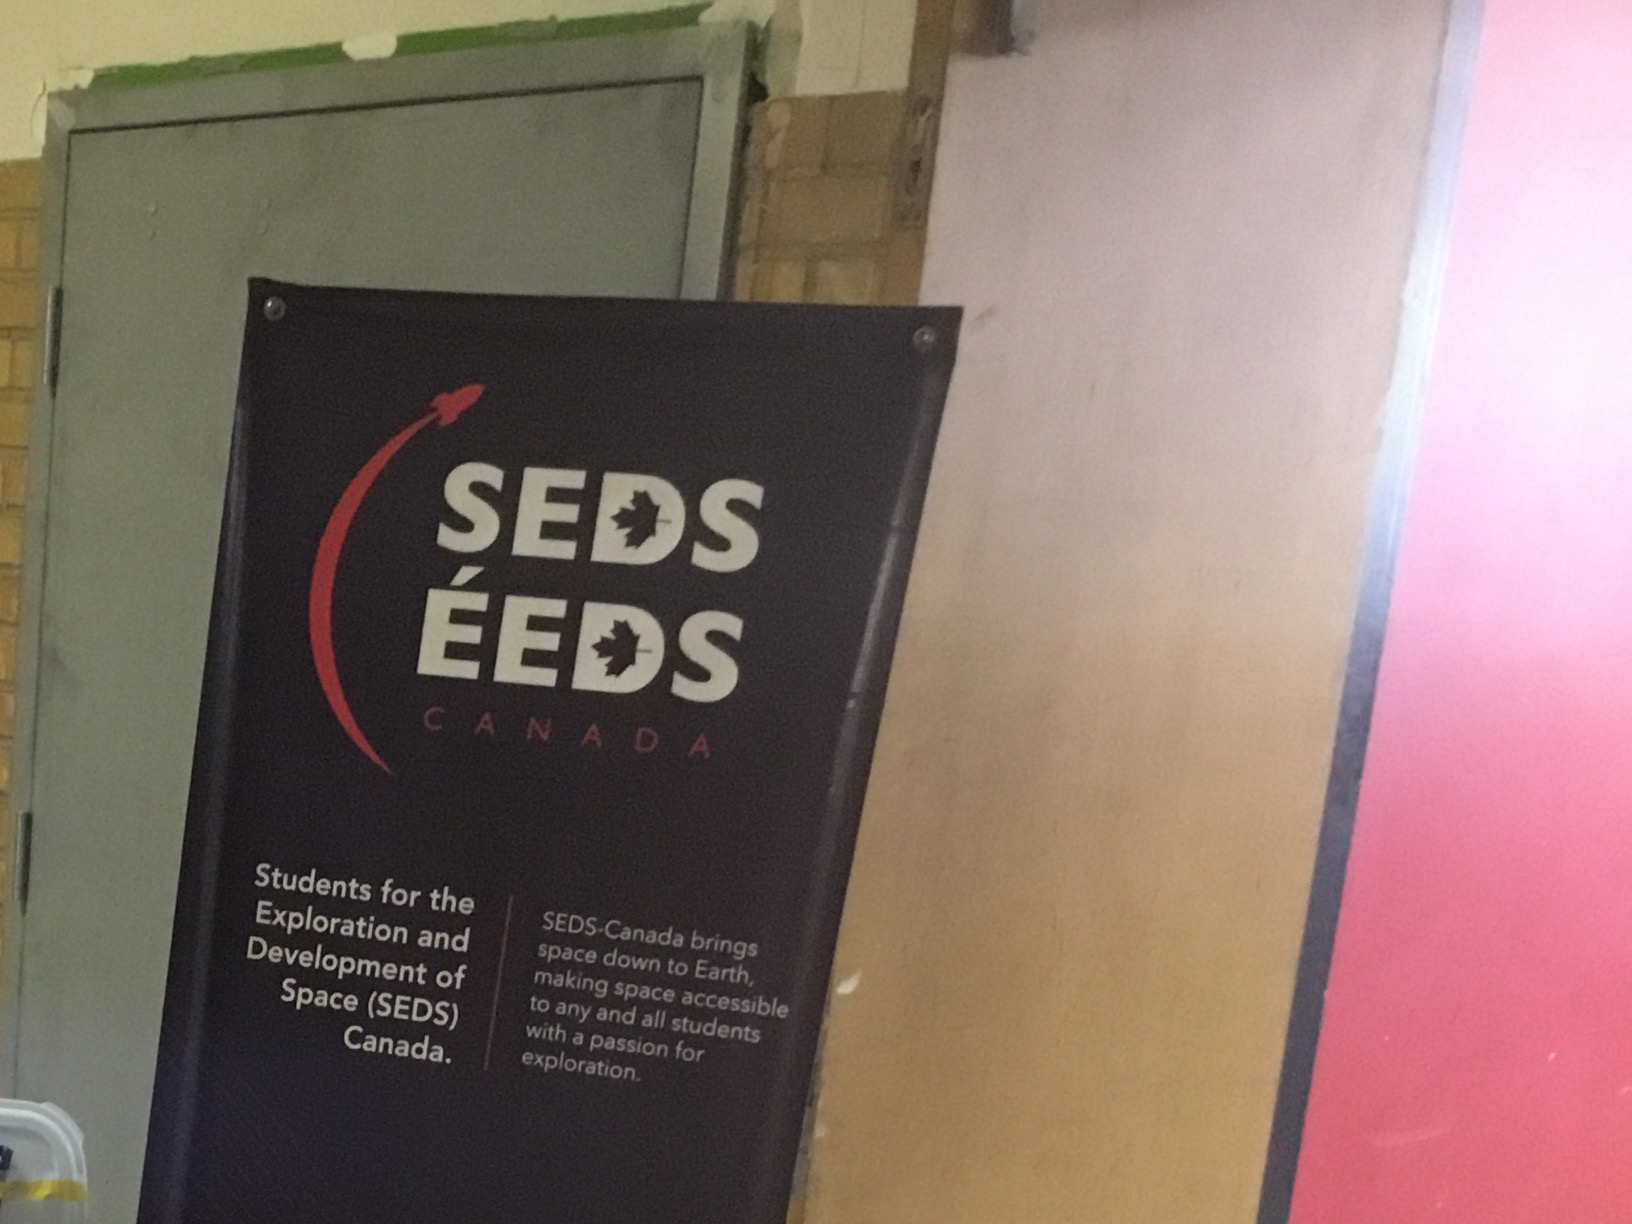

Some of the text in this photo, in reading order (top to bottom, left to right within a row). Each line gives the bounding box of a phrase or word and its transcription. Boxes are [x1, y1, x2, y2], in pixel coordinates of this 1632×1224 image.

[436, 461, 765, 573] SEDS
[416, 565, 745, 703] ÉEDS
[423, 706, 711, 759] CANADA
[254, 862, 475, 915] Students for the
[255, 900, 471, 953] Exploration and
[542, 911, 759, 961] SEDS-Canada brings
[246, 935, 468, 990] Development of
[537, 943, 754, 988] space down to Earth,
[280, 977, 459, 1031] Space (SEDS)
[530, 995, 761, 1044] to any and all students
[533, 969, 789, 1019] making space accessible
[343, 1024, 452, 1064] Canada.
[521, 1051, 642, 1082] exploration.
[525, 1022, 706, 1063] with a passion for
